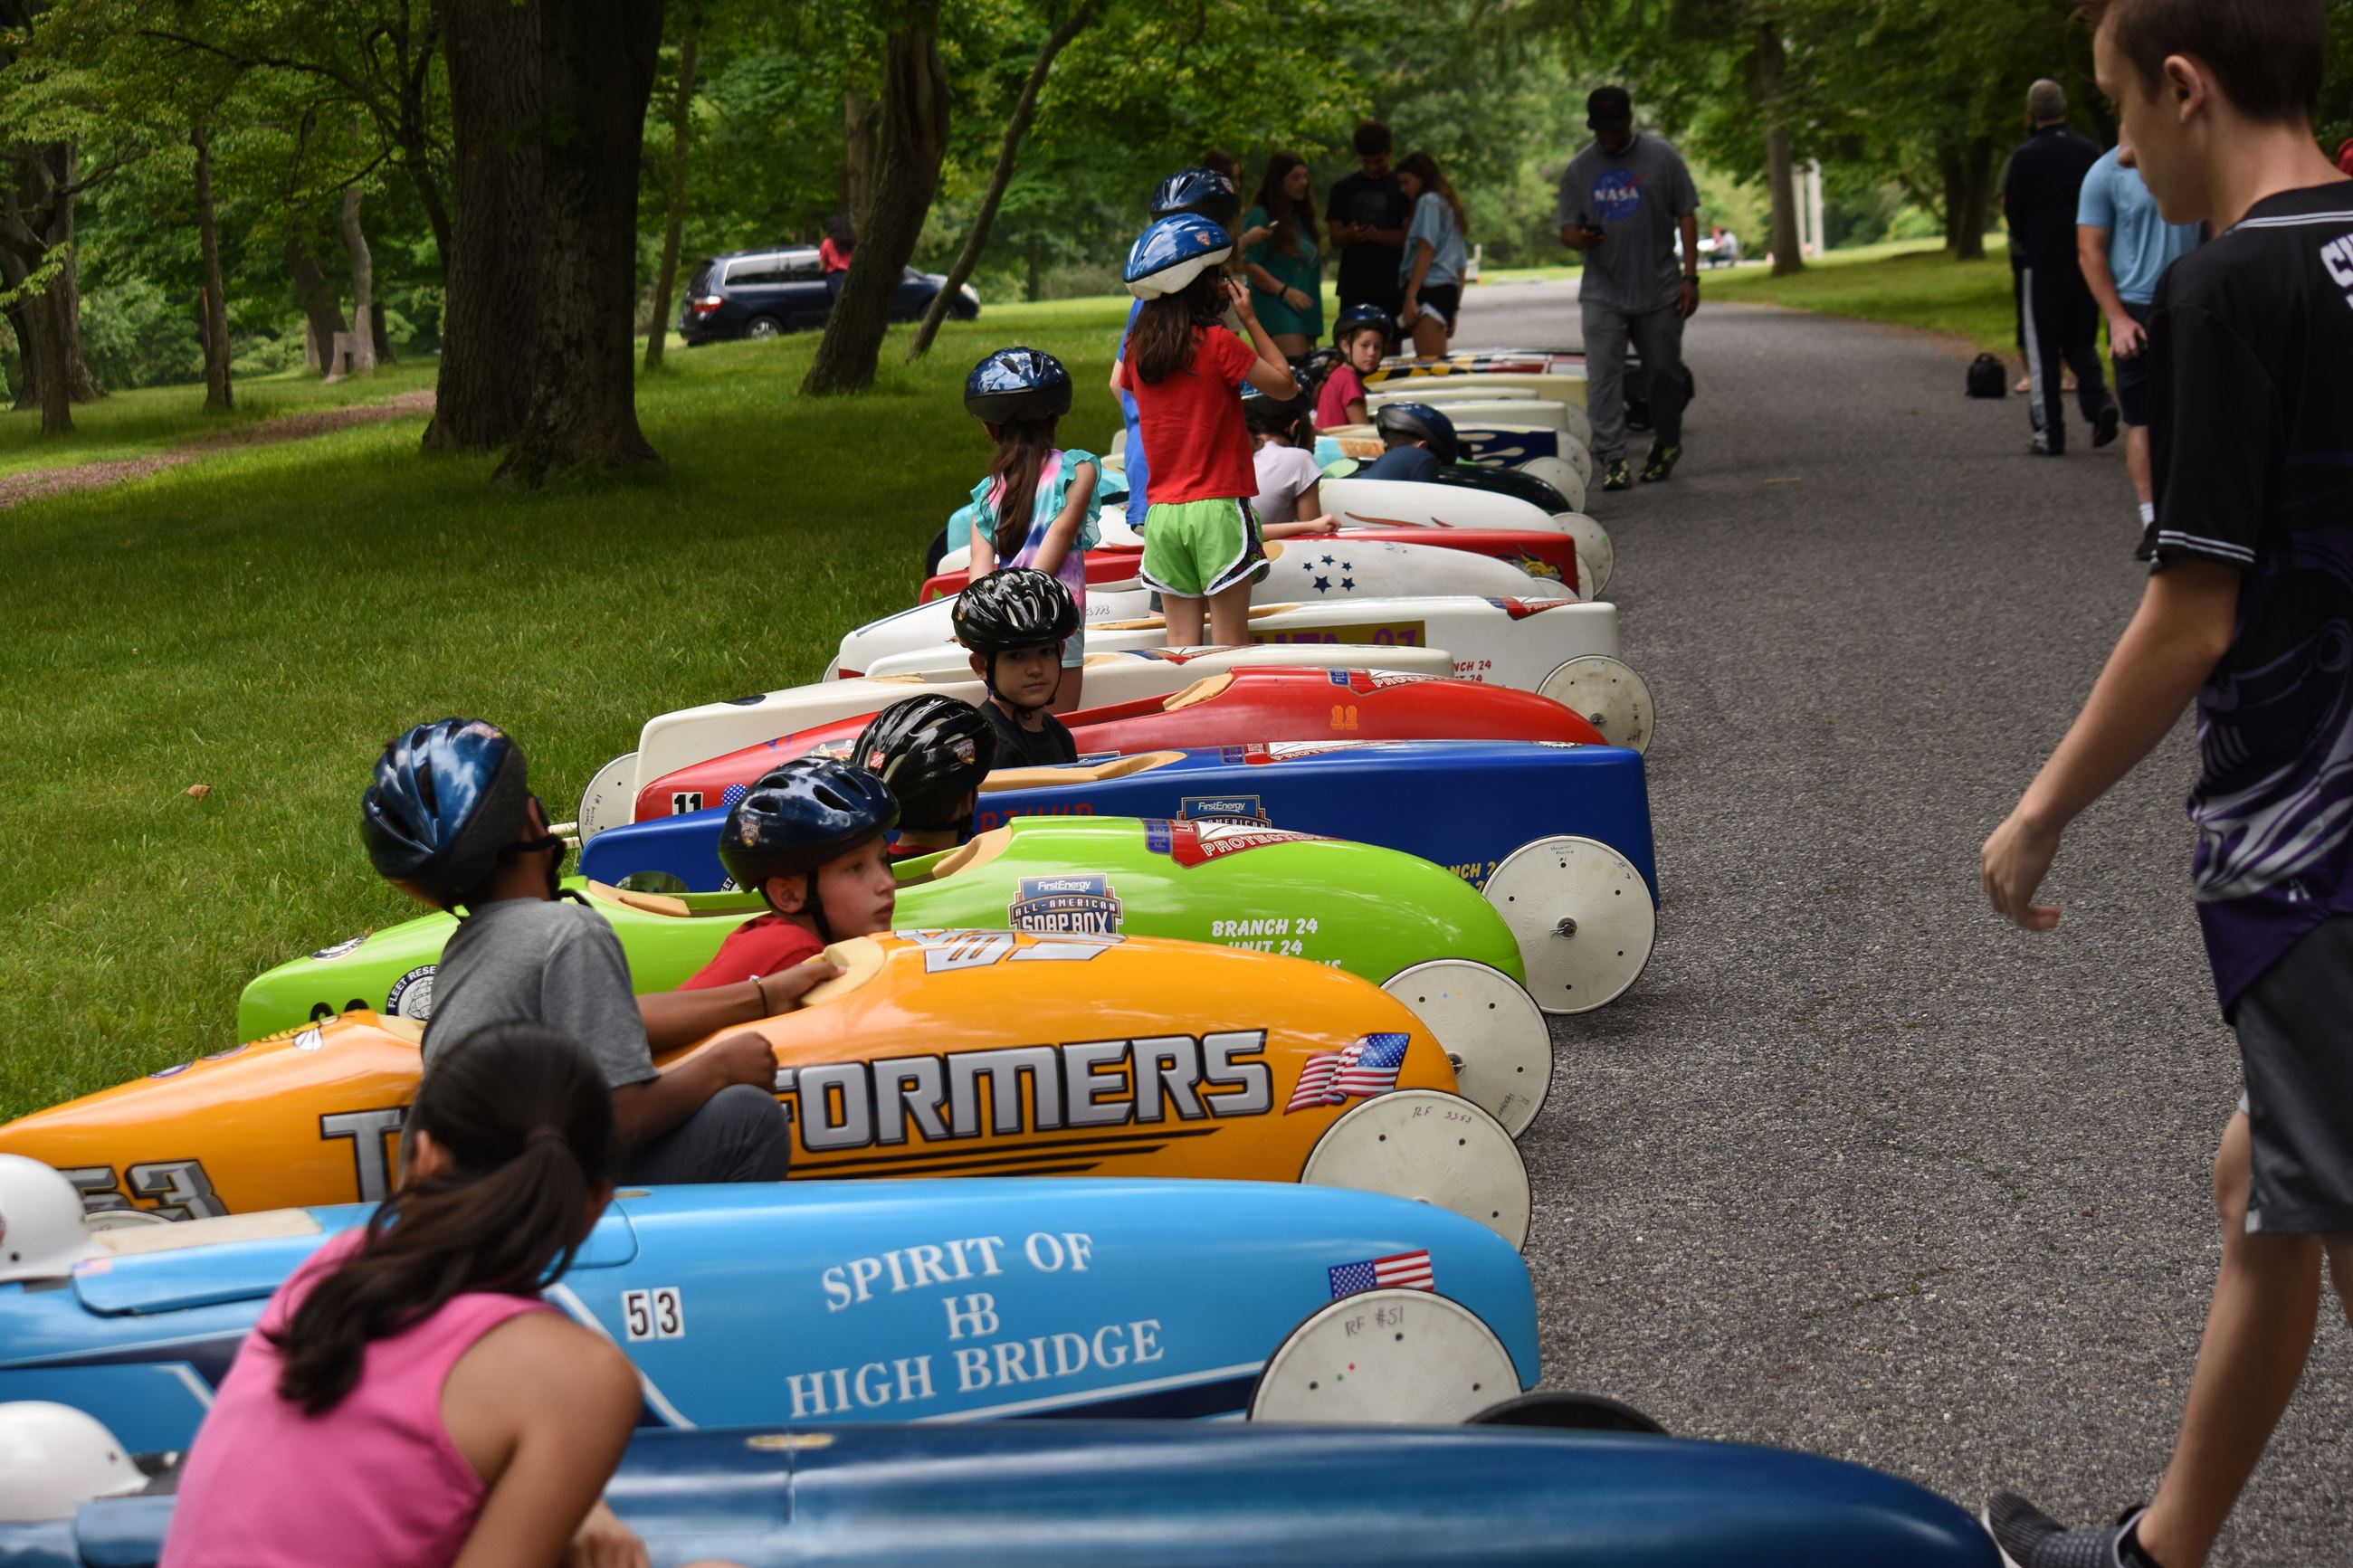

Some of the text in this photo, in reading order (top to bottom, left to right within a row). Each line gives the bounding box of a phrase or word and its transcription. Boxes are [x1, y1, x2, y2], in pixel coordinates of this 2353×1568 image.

[1594, 187, 1639, 202] NASA
[1453, 660, 1492, 672] NCH 24
[673, 793, 703, 814] 11
[1198, 802, 1246, 813] FirstEnergy
[1207, 818, 1266, 828] AMERICAN
[1448, 863, 1481, 879] NCH
[1037, 880, 1091, 892] FirstEnergy
[1015, 898, 1116, 917] ALL-AMERICAN
[1022, 911, 1109, 935] SOAP BOX
[1212, 917, 1319, 937] BRANCH 24
[1279, 939, 1303, 955] 24
[387, 965, 436, 1008] FLEET RESE
[1413, 1107, 1433, 1118] RF
[821, 1231, 1094, 1313] SPIRIT OF
[627, 1290, 679, 1336] 53
[942, 1292, 1001, 1341] HB
[1345, 1316, 1366, 1338] RF
[785, 1318, 1166, 1420] HIGH BRIDGE
